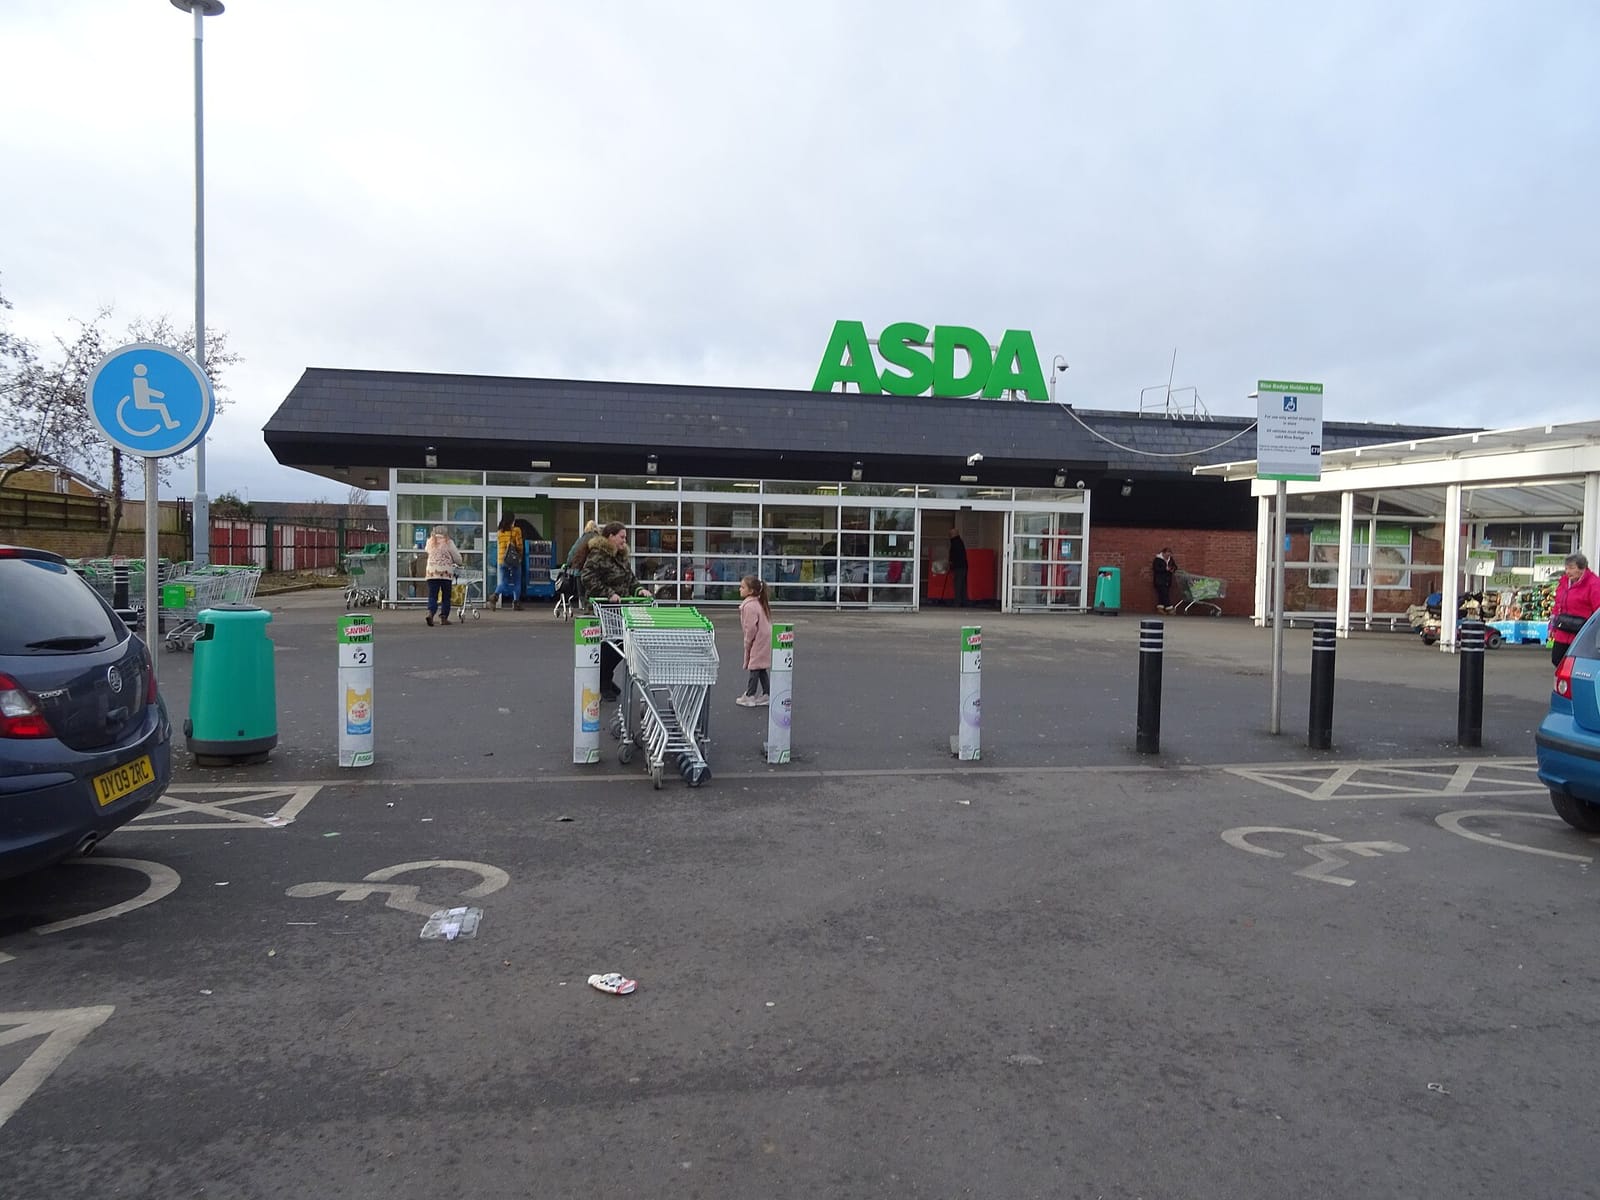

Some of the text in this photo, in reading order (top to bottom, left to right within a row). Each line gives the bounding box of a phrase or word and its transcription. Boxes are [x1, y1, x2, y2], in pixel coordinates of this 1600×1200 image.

[811, 320, 1050, 401] ASDA
[1272, 383, 1288, 391] Badge
[353, 653, 367, 664] £2
[589, 653, 600, 664] £2
[100, 760, 150, 799] DY09 ZRC
